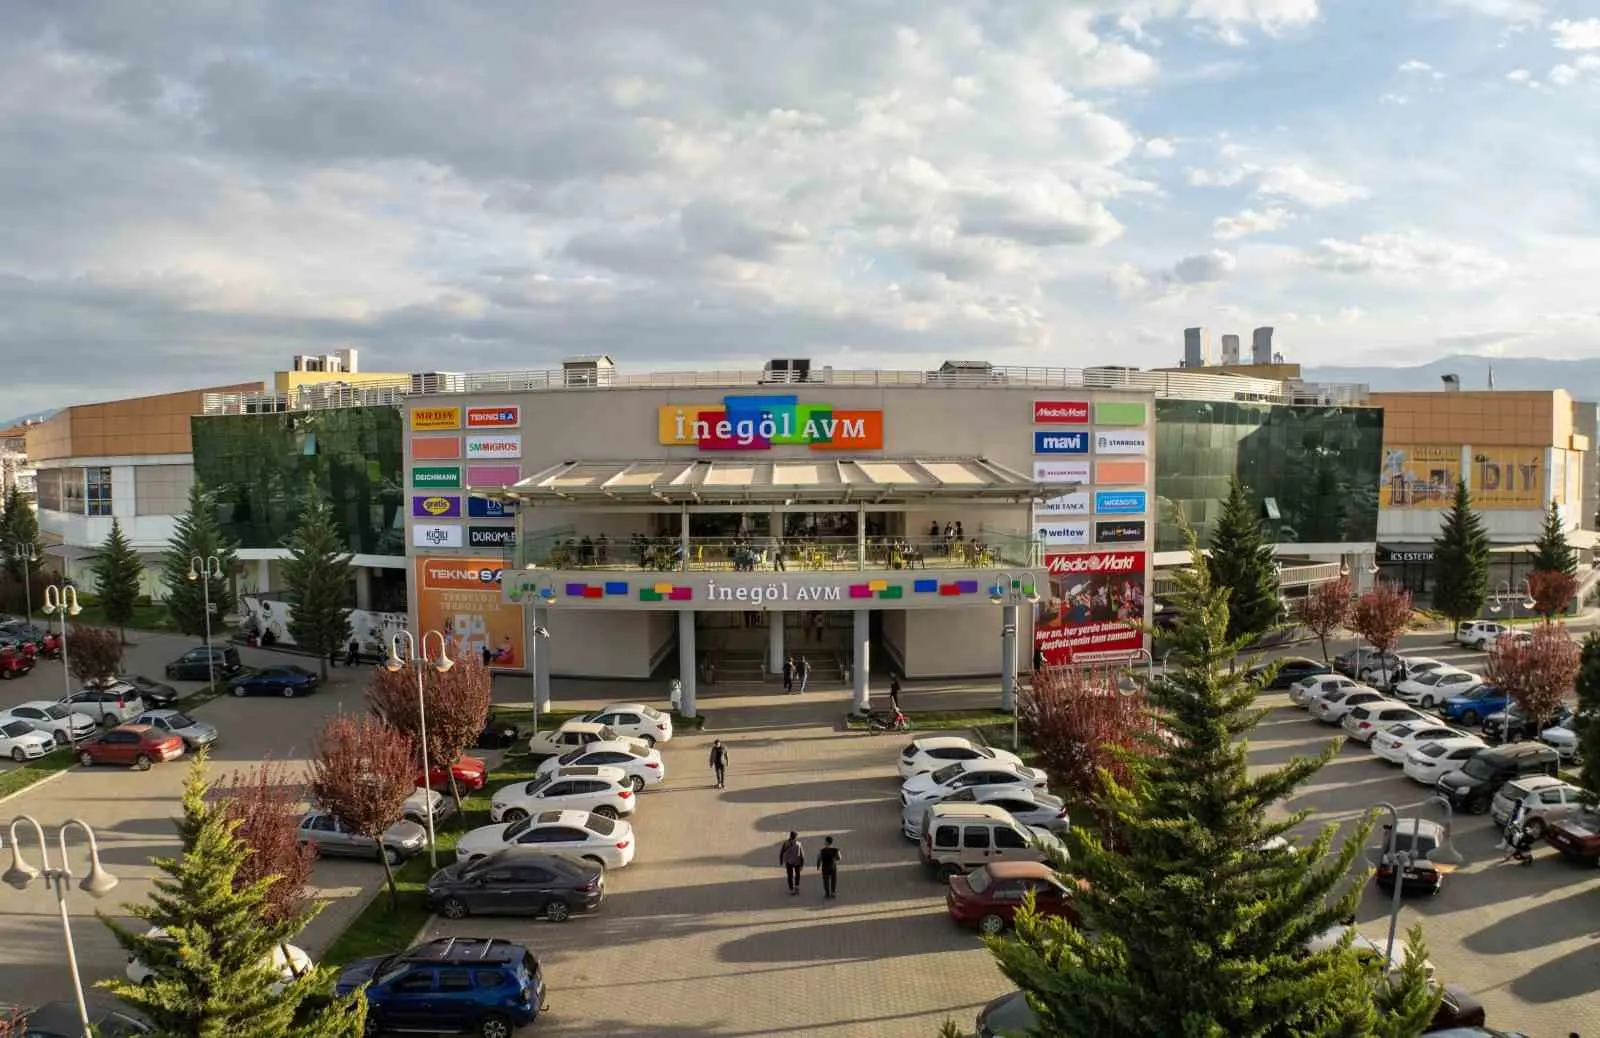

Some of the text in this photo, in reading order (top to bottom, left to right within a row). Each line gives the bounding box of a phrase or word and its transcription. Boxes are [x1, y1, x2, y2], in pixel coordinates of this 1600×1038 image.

[802, 418, 866, 438] AVM
[1043, 434, 1081, 449] mavi
[425, 500, 448, 509] gratis
[1048, 527, 1084, 537] weltew
[1047, 554, 1134, 572] Media Markt
[430, 568, 503, 581] TEKNOSA
[796, 585, 841, 601] AVM
[1036, 630, 1050, 640] Her
[1064, 627, 1079, 637] her
[1078, 624, 1101, 637] yerde
[1091, 633, 1106, 643] tam
